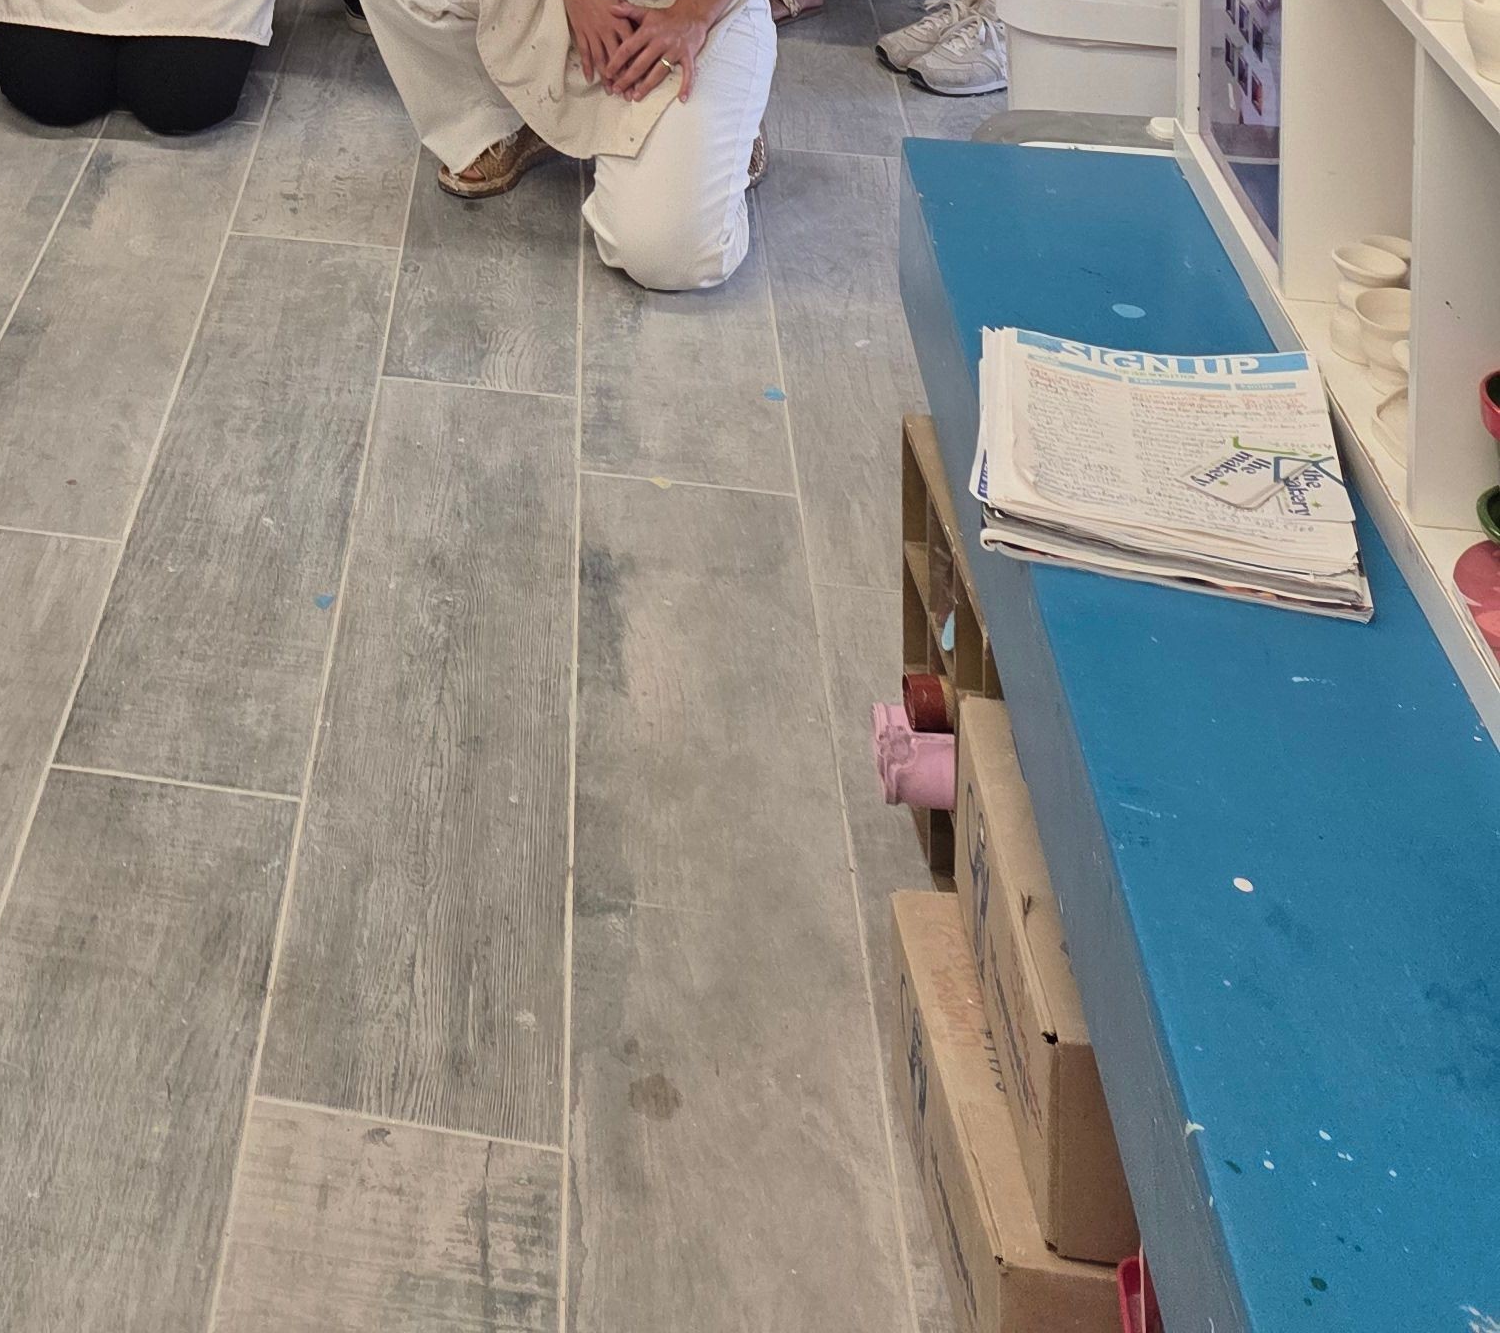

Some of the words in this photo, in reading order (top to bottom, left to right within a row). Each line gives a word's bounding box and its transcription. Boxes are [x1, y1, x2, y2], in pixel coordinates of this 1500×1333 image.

[1056, 341, 1180, 376] SIGN
[1194, 357, 1260, 376] UP
[1189, 450, 1255, 488] makery
[1240, 457, 1273, 475] the
[1302, 468, 1325, 490] the
